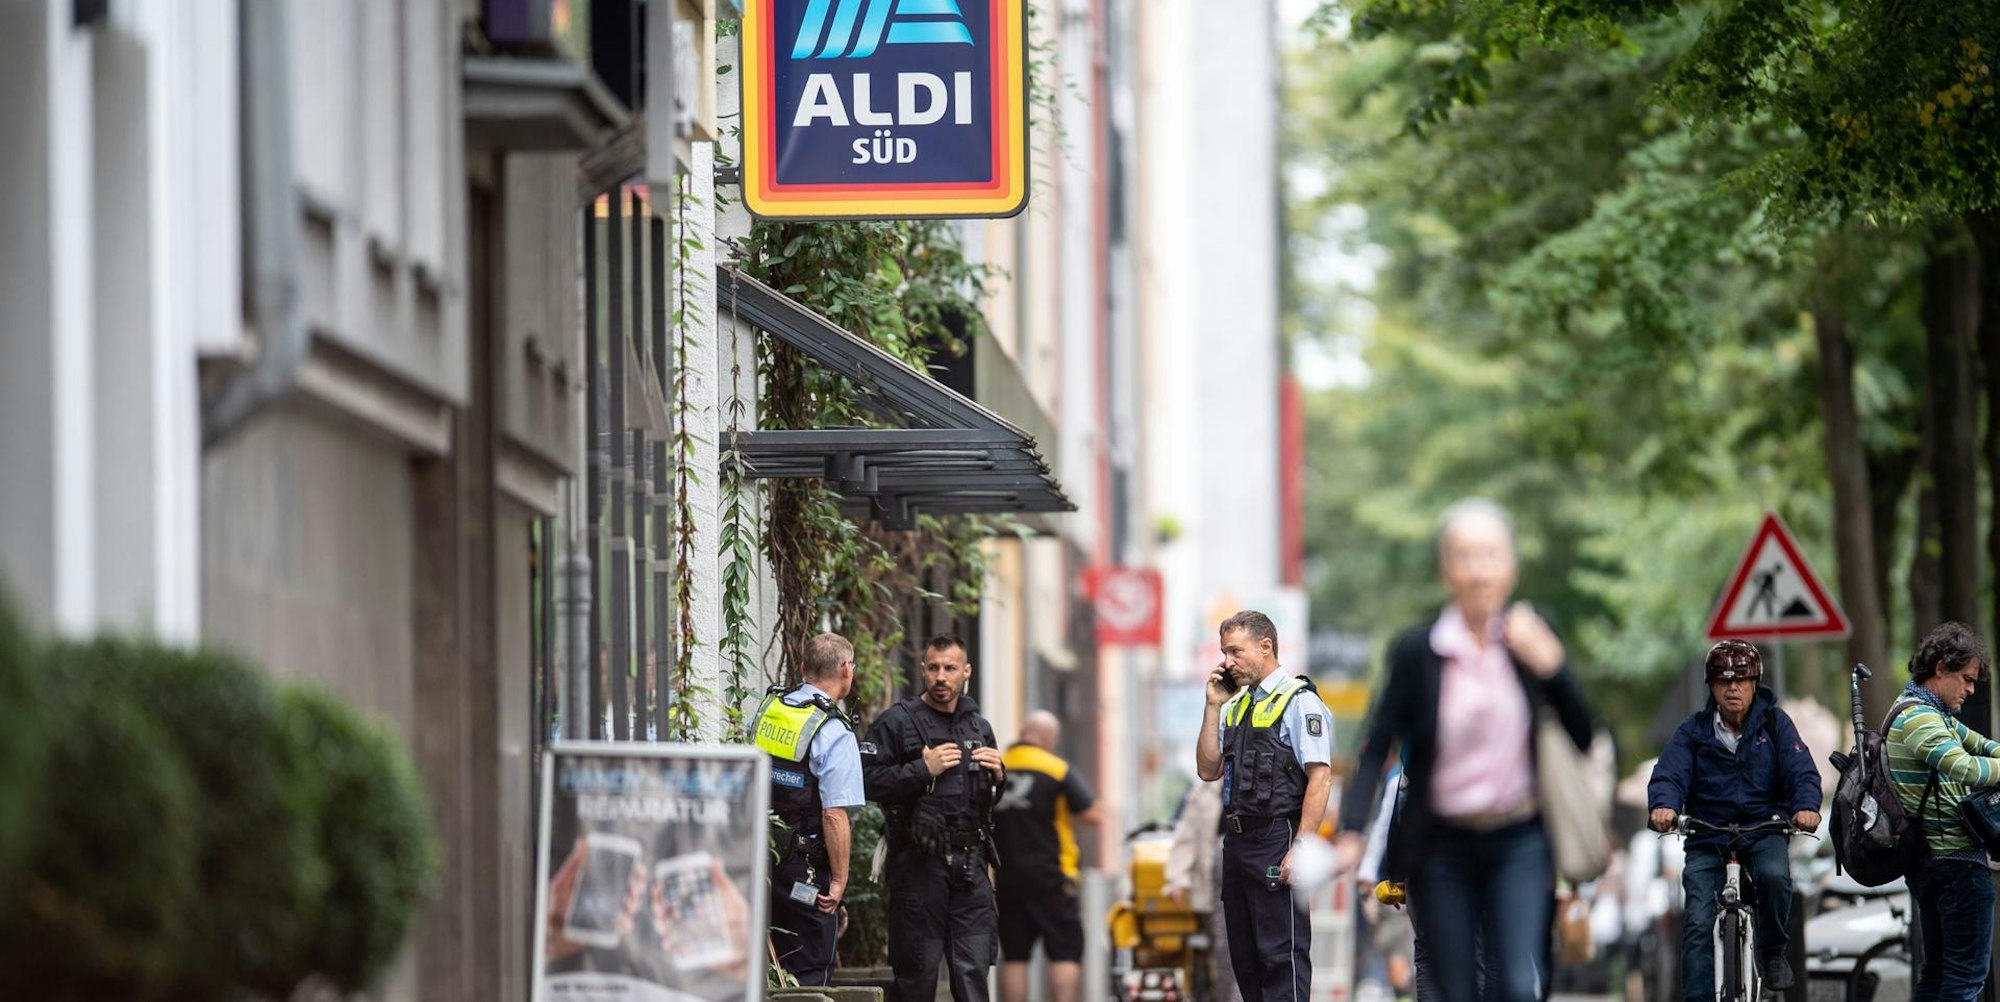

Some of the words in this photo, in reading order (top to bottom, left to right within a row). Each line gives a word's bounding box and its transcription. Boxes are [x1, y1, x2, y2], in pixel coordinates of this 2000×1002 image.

[792, 71, 973, 127] ALDI
[851, 129, 918, 165] SÜD
[758, 721, 797, 747] POLIZEI
